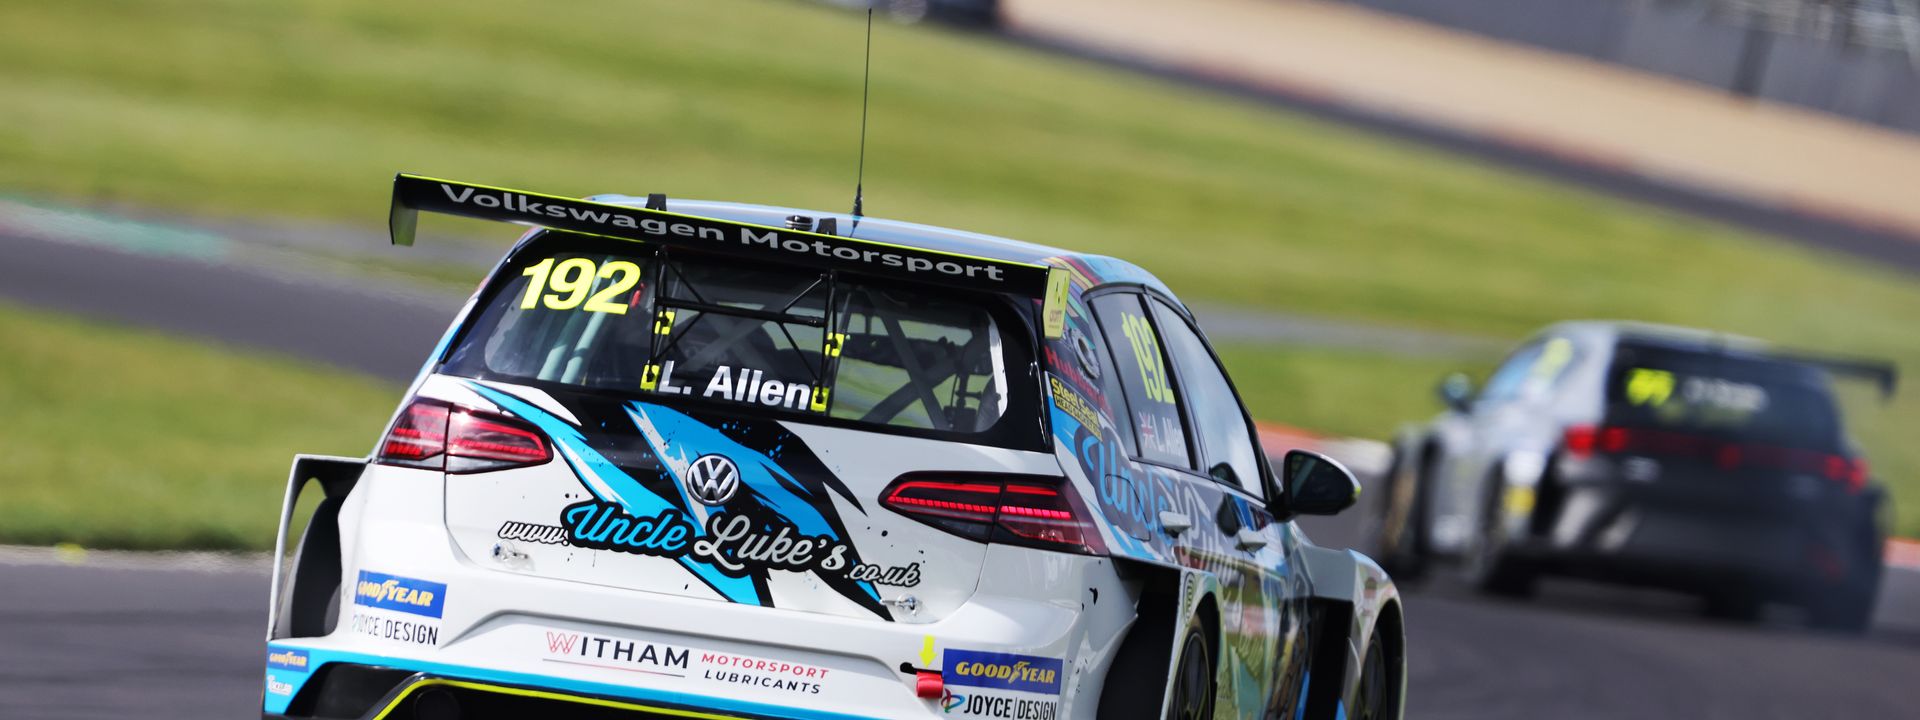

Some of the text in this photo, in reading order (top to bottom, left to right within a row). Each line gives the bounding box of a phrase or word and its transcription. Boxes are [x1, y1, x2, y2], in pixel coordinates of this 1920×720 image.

[440, 183, 1004, 281] Volkswagen Motorsport
[520, 257, 641, 315] 192
[1121, 311, 1176, 404] 192
[658, 360, 811, 411] L. Allen
[565, 502, 689, 552] Uncle
[693, 514, 848, 572] Luke's
[384, 619, 438, 646] DESIGN
[546, 630, 690, 670] WITHAM
[701, 652, 829, 680] MOTORSPORT
[704, 669, 821, 695] LUBRICANTS
[955, 660, 1056, 685] GOODYEAR
[963, 693, 1057, 720] JOYCE DESIGN
